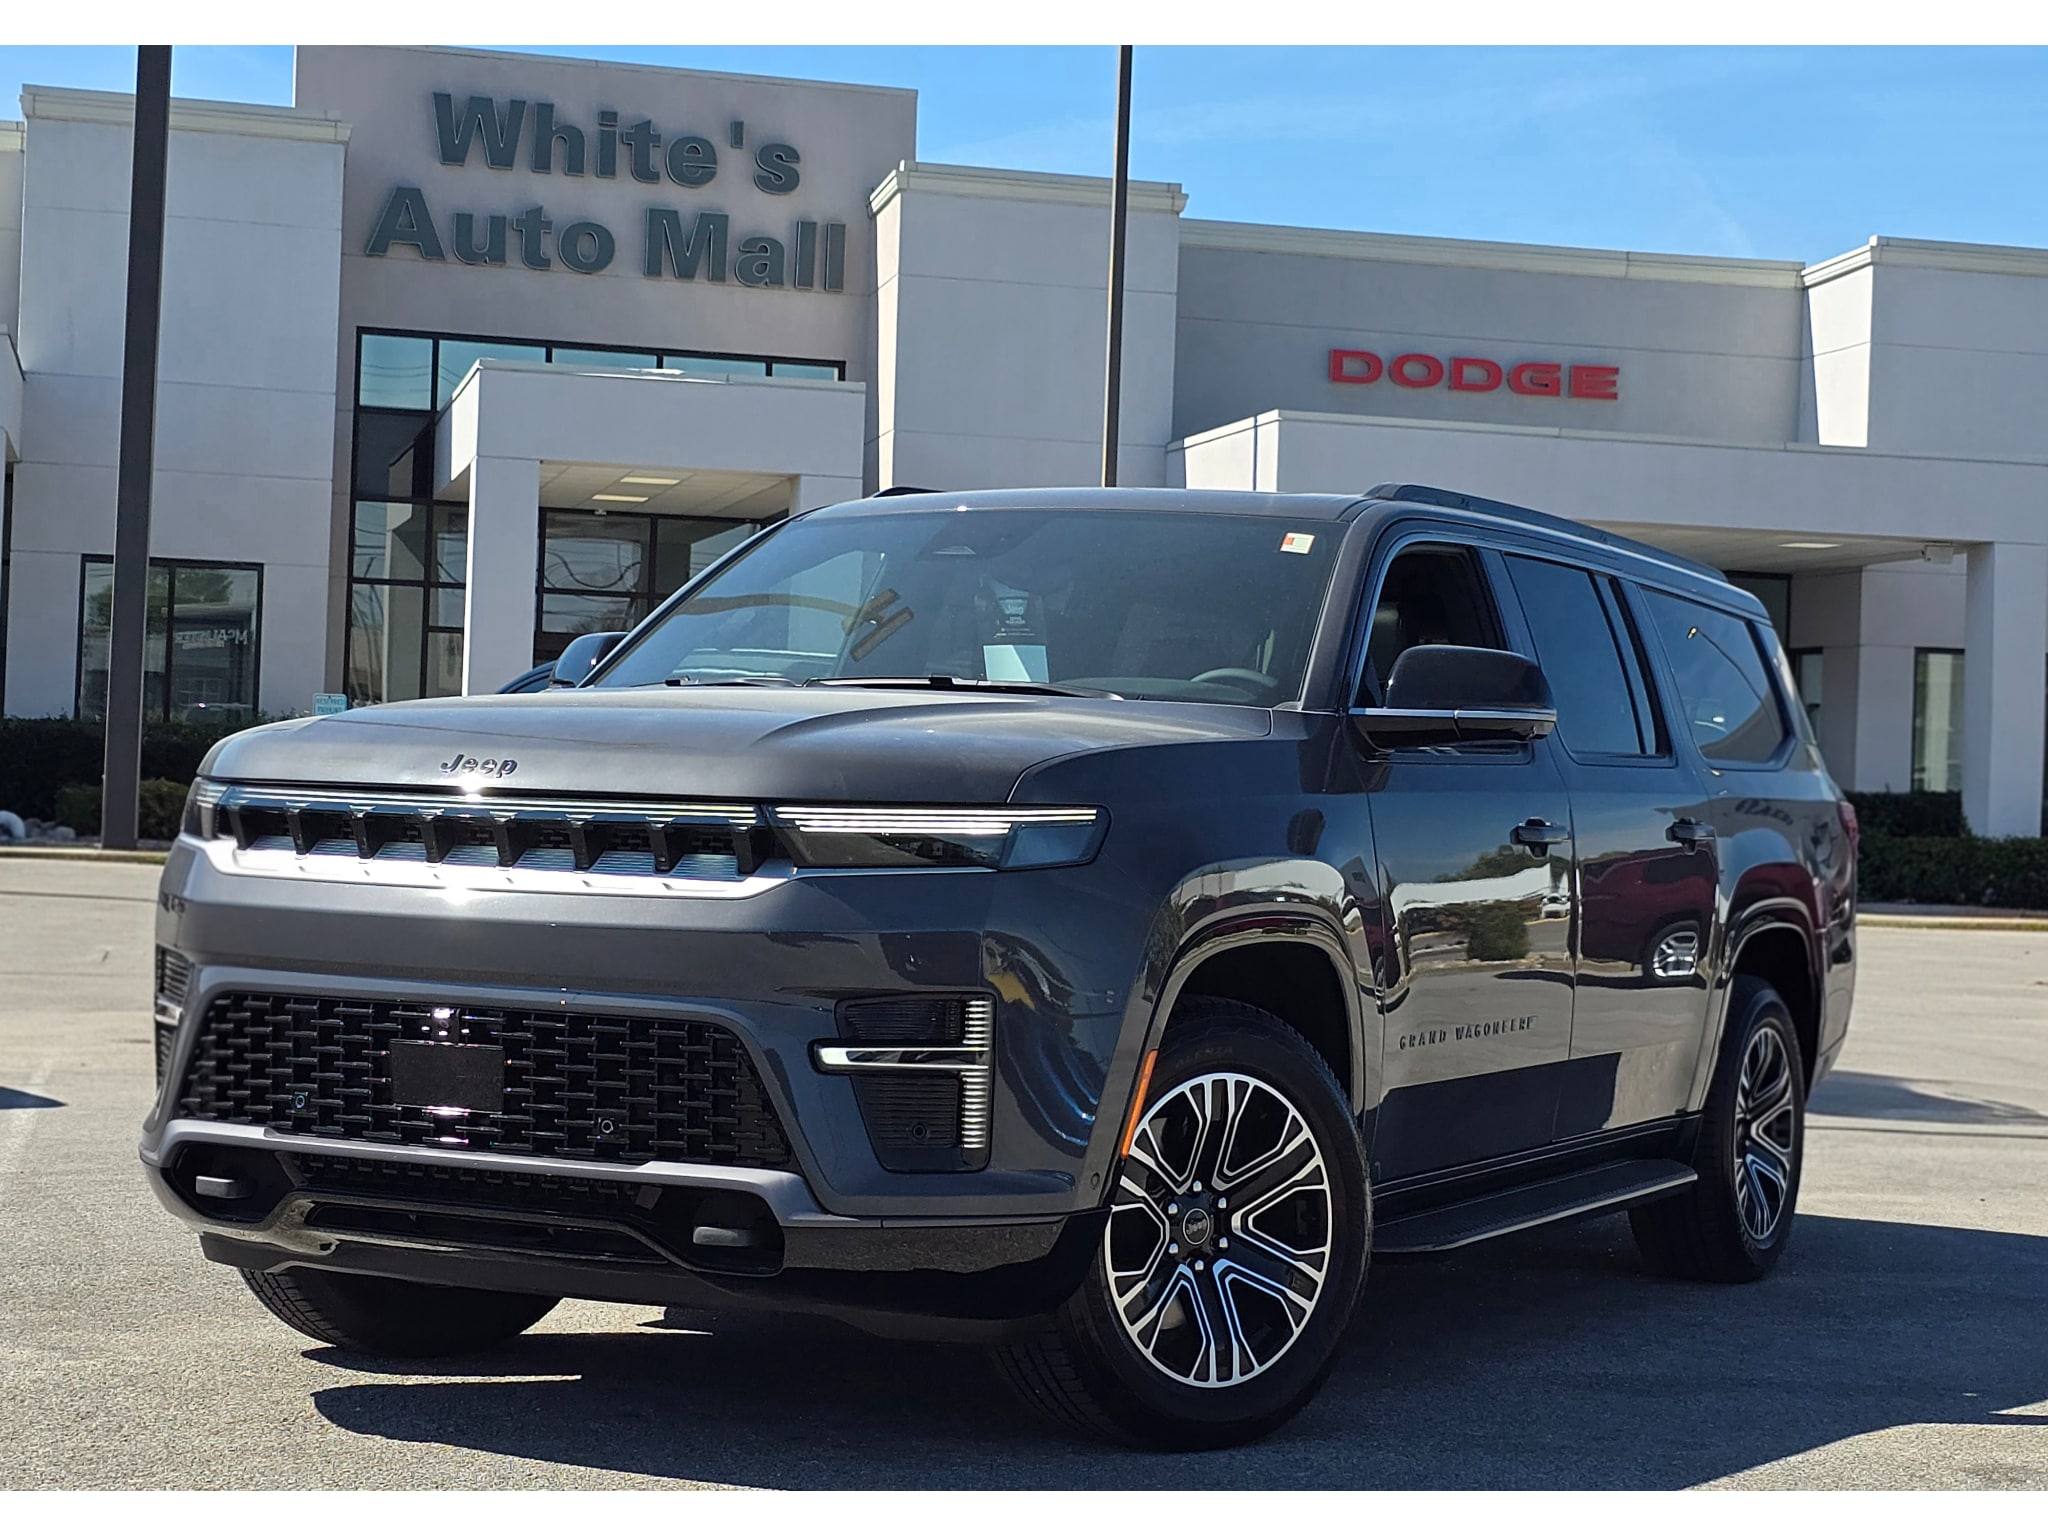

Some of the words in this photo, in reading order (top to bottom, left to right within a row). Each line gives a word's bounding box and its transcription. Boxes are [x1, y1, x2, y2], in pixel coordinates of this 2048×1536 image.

[431, 92, 801, 196] White's
[365, 186, 616, 274] Auto
[644, 208, 847, 292] Mall
[1328, 349, 1619, 400] DODGE
[440, 754, 518, 778] Jeep
[1399, 1029, 1447, 1050] GRAND
[1455, 1017, 1527, 1040] WAGONEER
